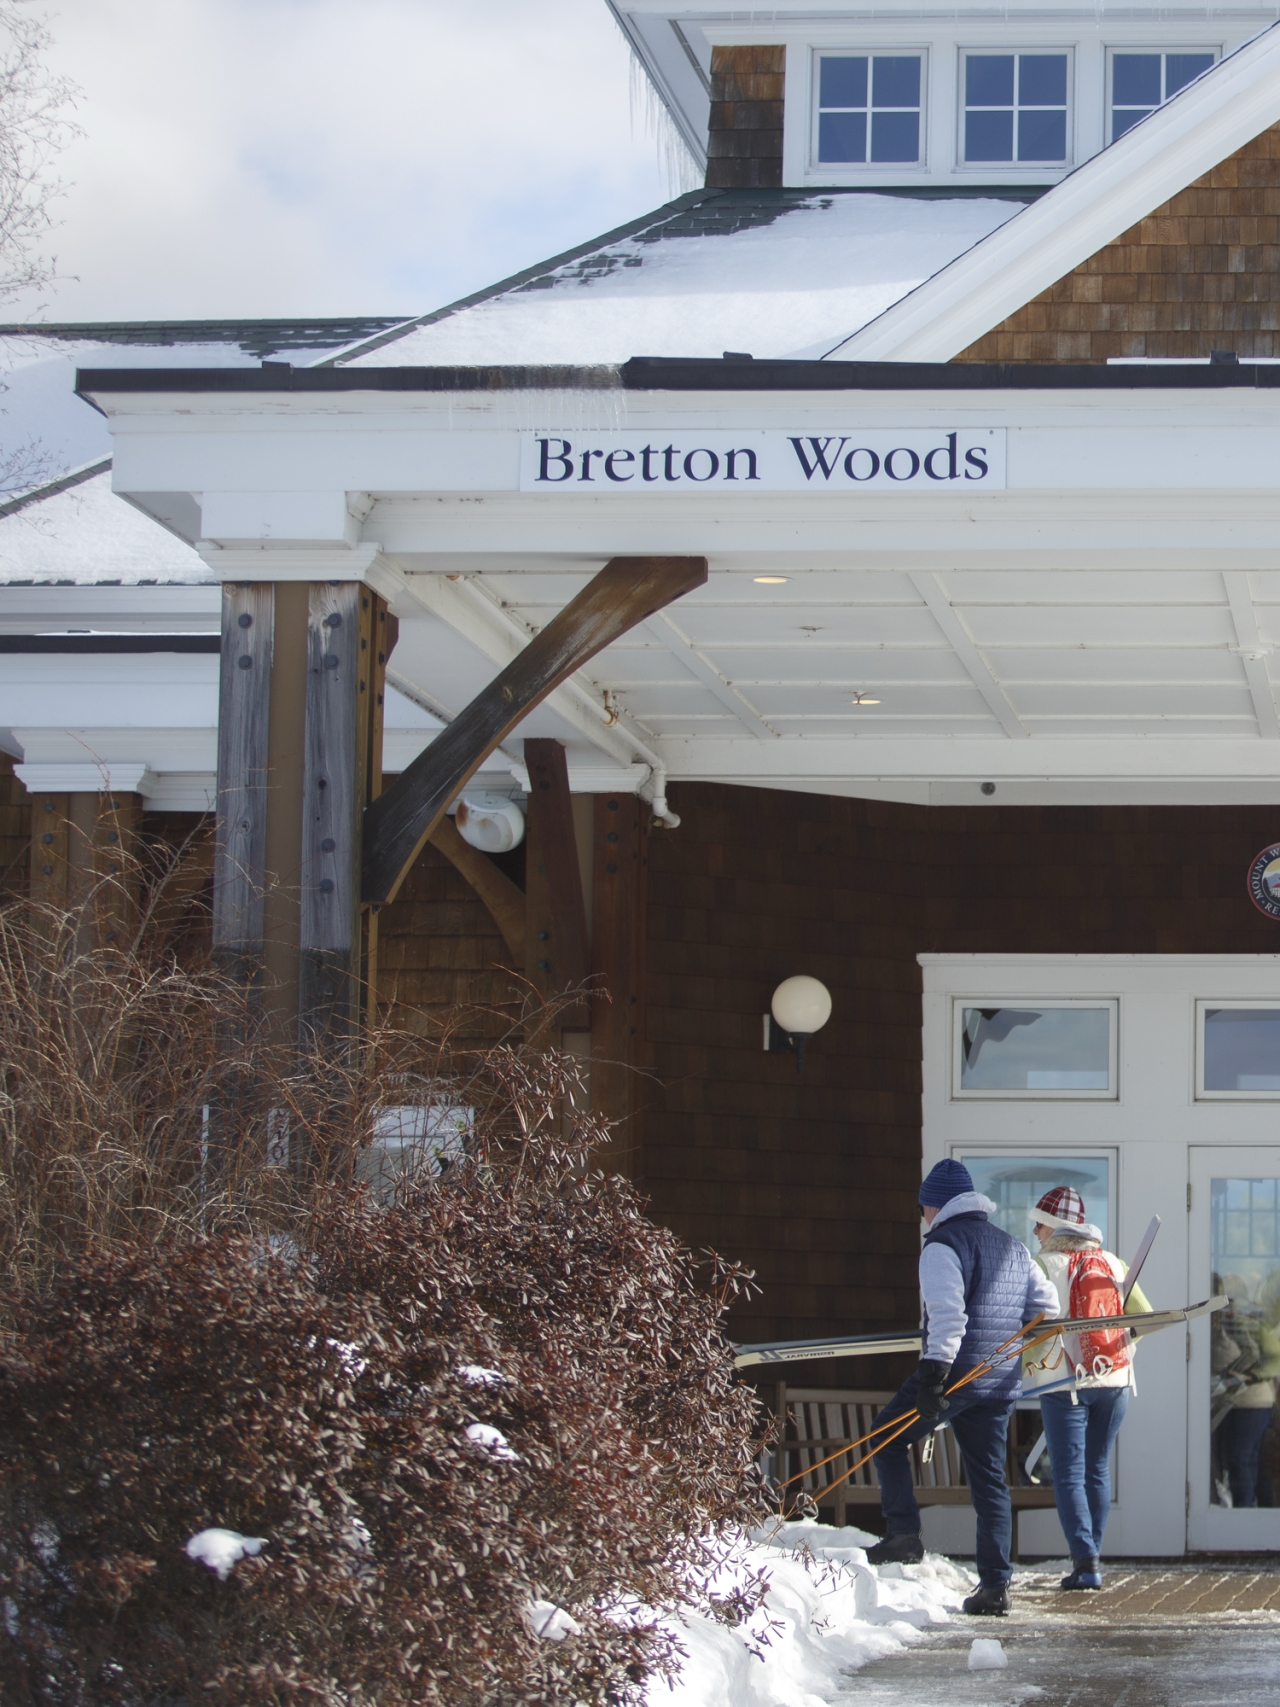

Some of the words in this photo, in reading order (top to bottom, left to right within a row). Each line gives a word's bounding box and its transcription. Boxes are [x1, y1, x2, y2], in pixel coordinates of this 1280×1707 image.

[534, 438, 761, 482] Bretton
[786, 431, 990, 481] Woods
[1251, 855, 1269, 900] MOUNT
